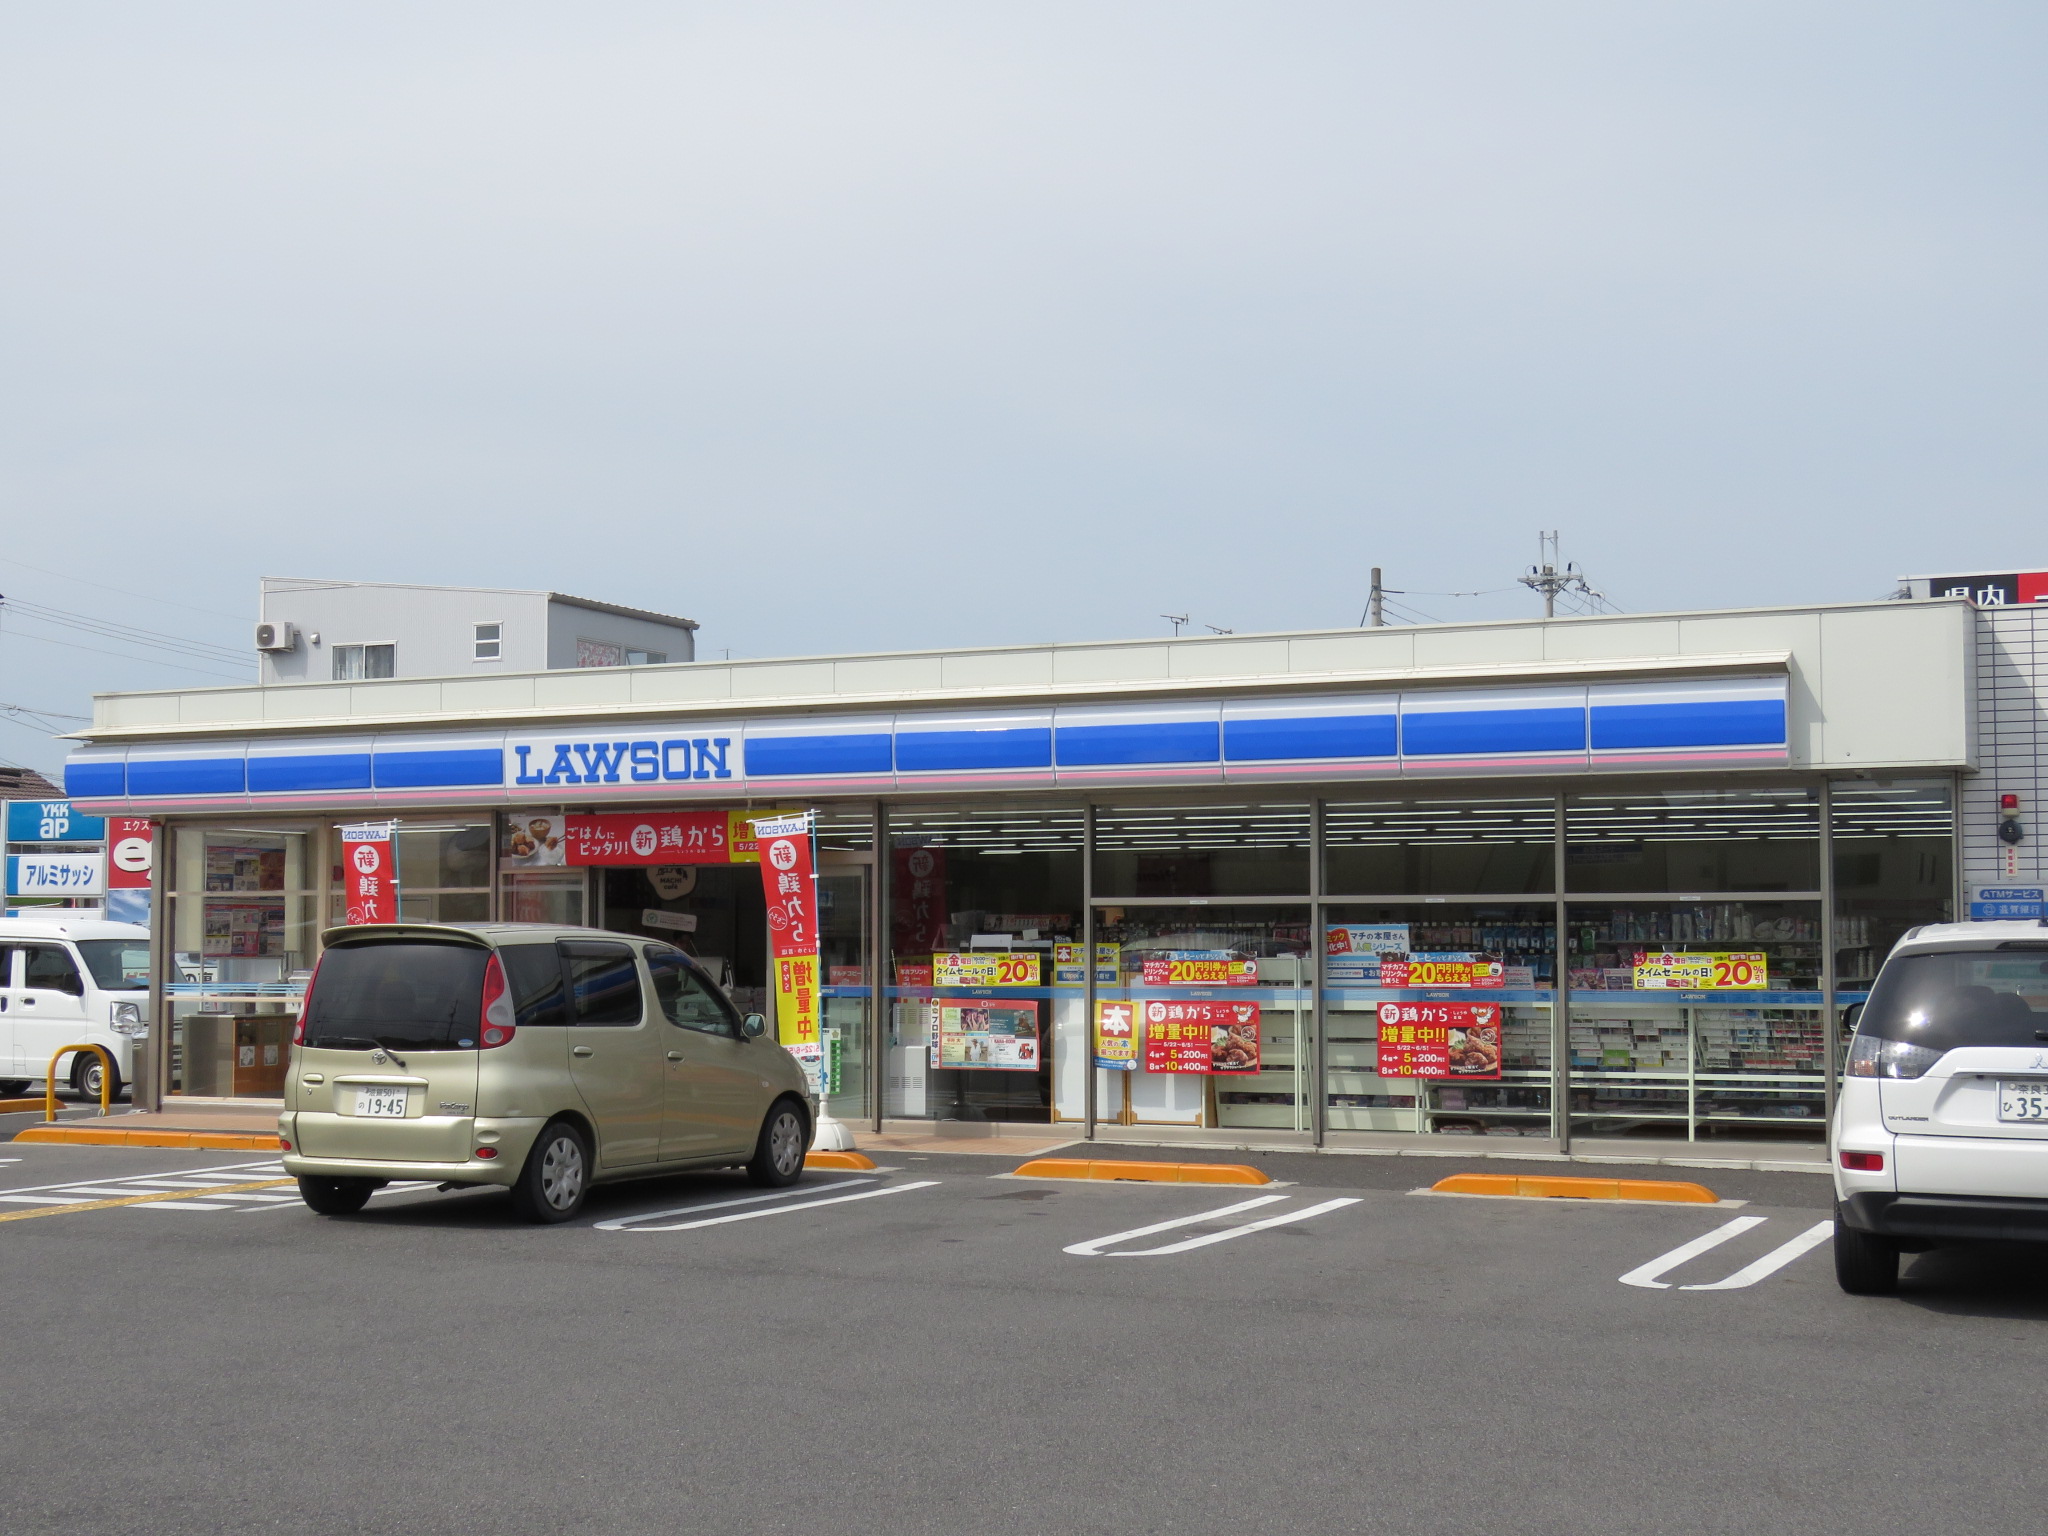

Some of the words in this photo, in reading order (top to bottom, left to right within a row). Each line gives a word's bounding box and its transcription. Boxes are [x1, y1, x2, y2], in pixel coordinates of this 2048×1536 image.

[515, 738, 731, 784] LAWSON
[41, 804, 69, 817] YKK
[40, 818, 69, 838] ap
[123, 821, 152, 831] エクス
[567, 826, 615, 840] ごはんに
[733, 821, 755, 838] 増
[636, 830, 653, 850] 新
[660, 825, 724, 848] 鶏から
[580, 841, 628, 856] ピッタリ!
[26, 865, 94, 886] アルミサッシ
[1982, 890, 2039, 898] ATMサービス
[1350, 931, 1405, 940] マチの本屋さん
[1327, 941, 1348, 952] 化中!
[1354, 942, 1402, 952] 人気シリーズ
[1058, 947, 1070, 961] 本
[936, 967, 997, 976] タイムセールの日!
[1169, 961, 1195, 981] 20
[1195, 962, 1227, 971] 円引券が
[1408, 962, 1436, 983] 20
[1436, 963, 1471, 973] 円引券が
[1637, 967, 1712, 977] タイムセールの日!
[1195, 972, 1227, 980] もらえる!
[1437, 973, 1471, 982] もらえる!
[1151, 1006, 1163, 1018] 新
[1168, 1005, 1211, 1020] 鶏から
[1384, 1008, 1396, 1020] 新
[1401, 1007, 1448, 1022] 鶏から
[1103, 1005, 1130, 1035] 本
[1149, 1023, 1208, 1040] 増量中!!
[1381, 1026, 1445, 1043] 増量中!!
[367, 1098, 403, 1115] 19-45
[2003, 1102, 2013, 1112] ひ
